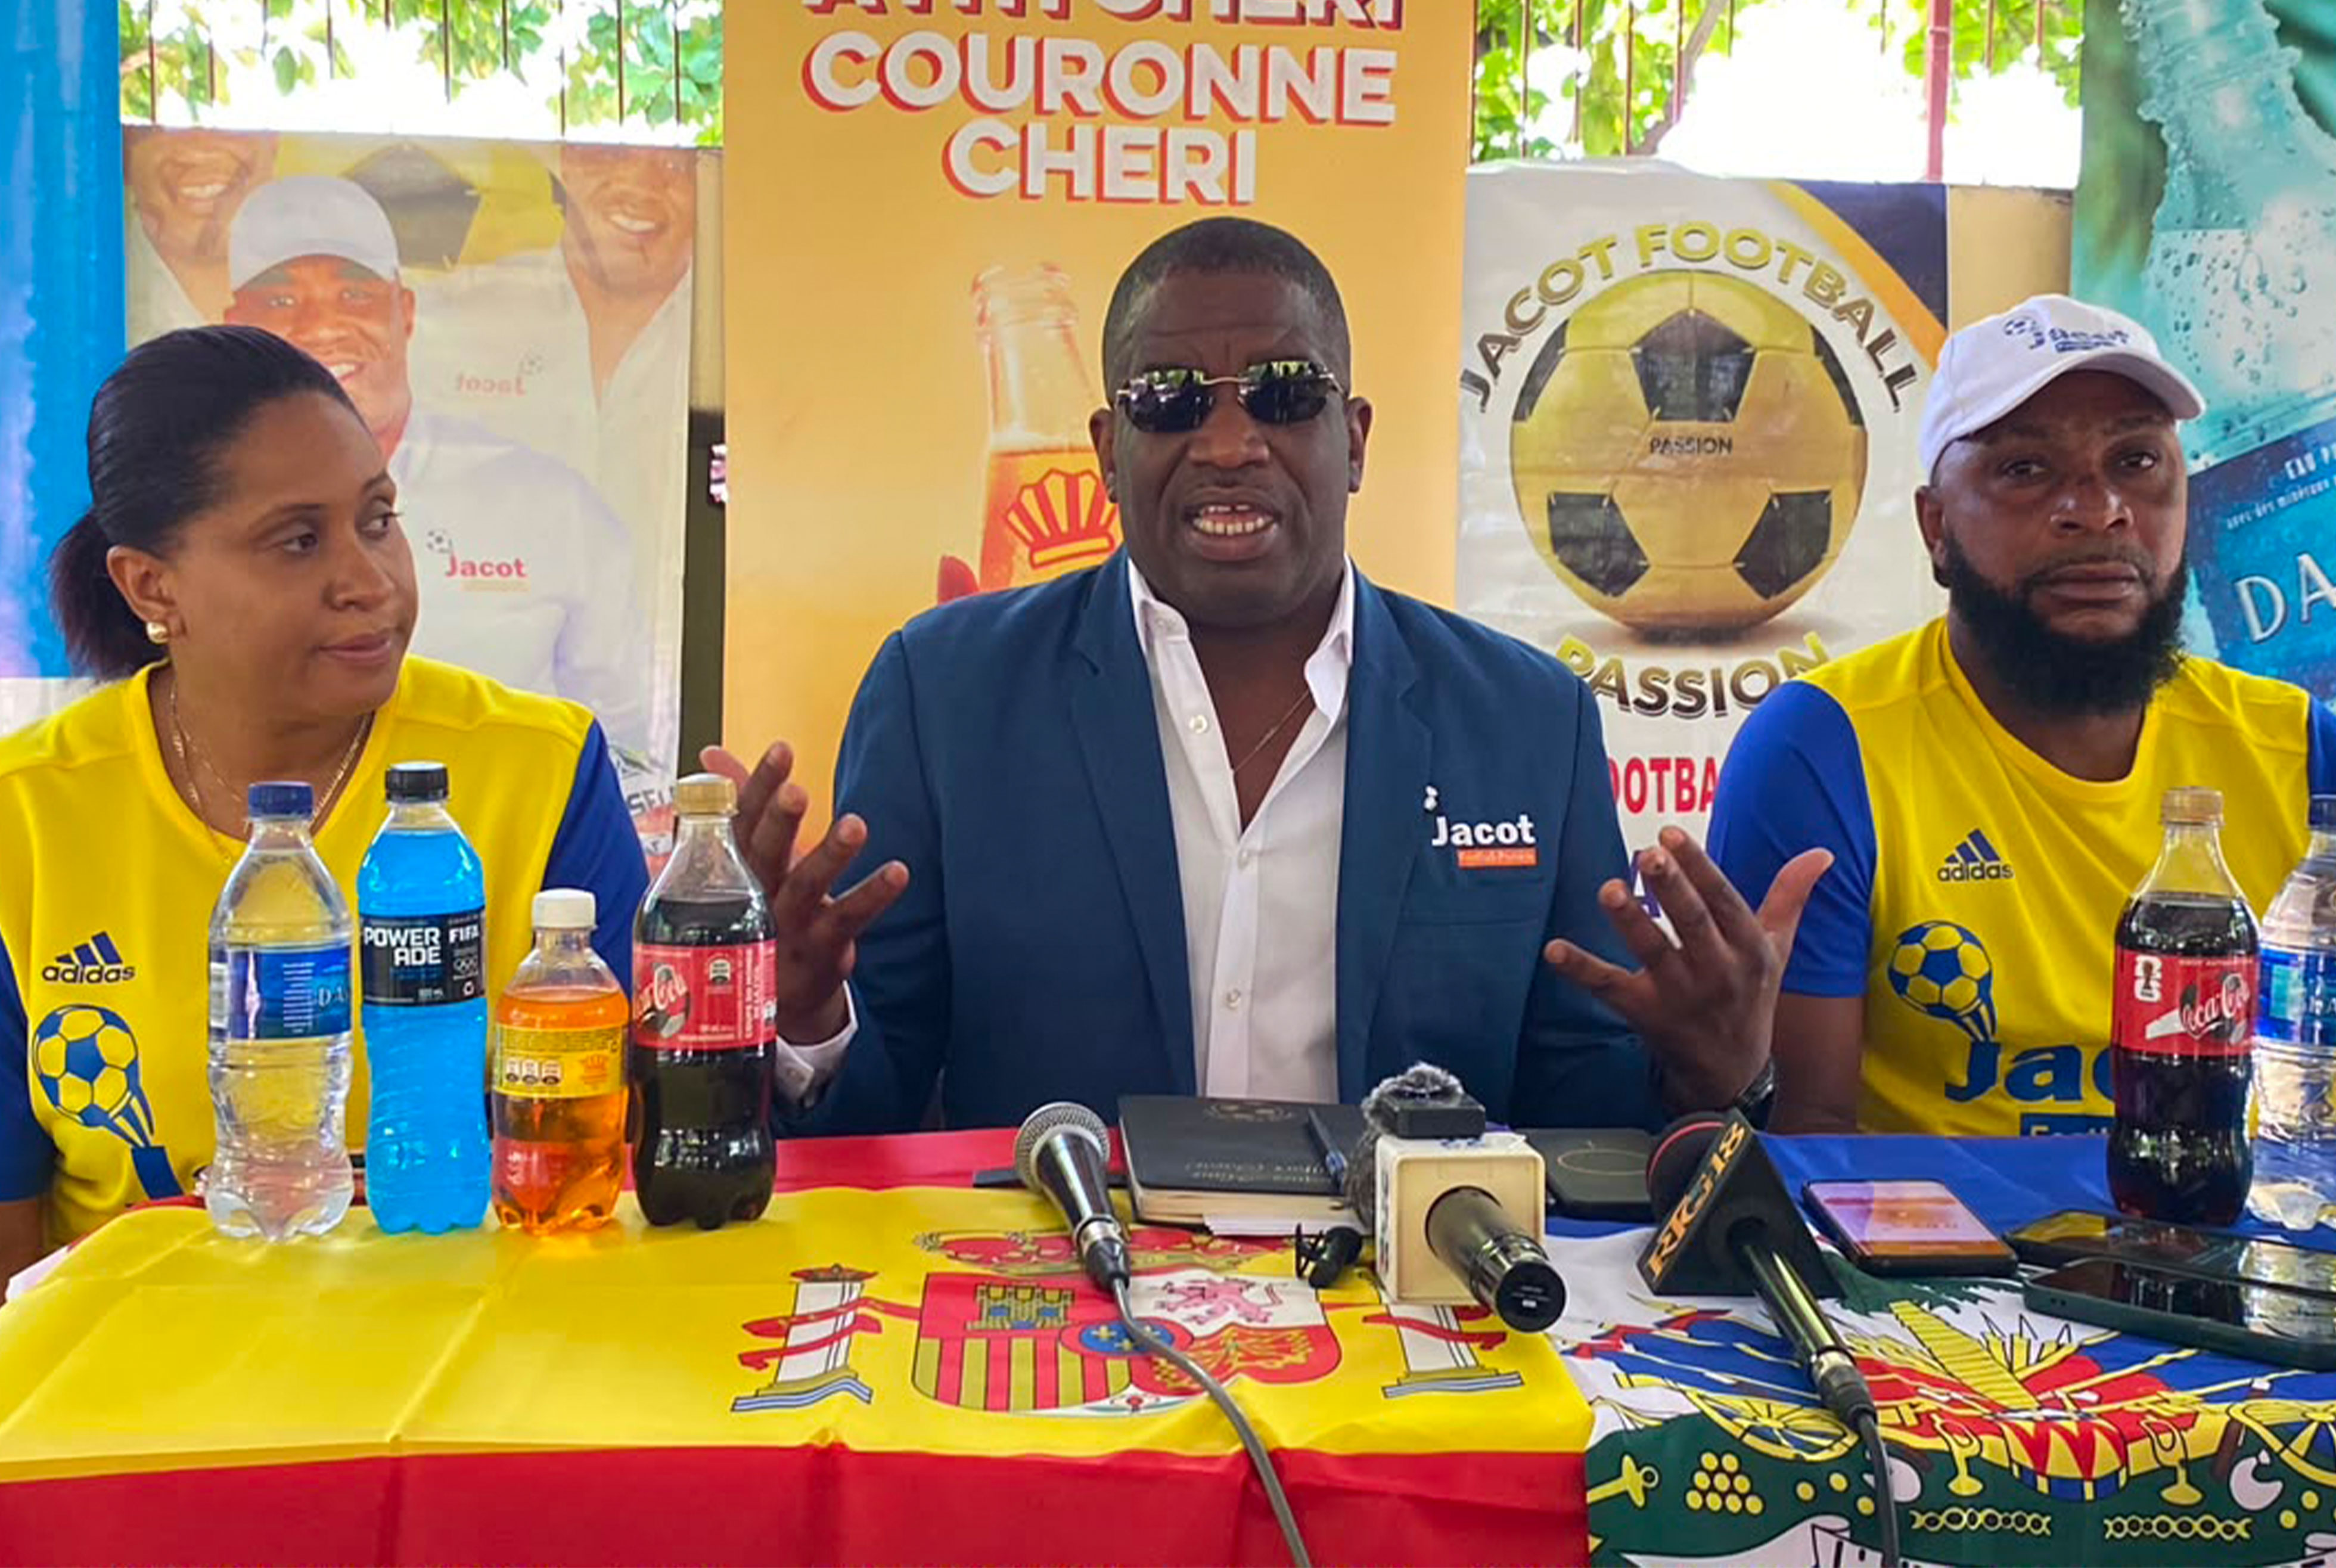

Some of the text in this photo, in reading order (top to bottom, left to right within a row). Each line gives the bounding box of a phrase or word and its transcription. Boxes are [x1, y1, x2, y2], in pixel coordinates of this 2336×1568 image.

[802, 31, 1396, 125] COURONNE
[943, 119, 1256, 205] CHERI
[1460, 220, 1917, 412] JACOT FOOTBALL
[1650, 437, 1732, 455] PASSION
[445, 551, 528, 578] Jacot
[1555, 630, 1831, 719] PASSION
[1431, 814, 1536, 847] Jacot
[1937, 862, 2014, 882] adidas
[363, 926, 442, 947] POWER
[449, 924, 479, 943] FIFA
[393, 946, 442, 966] ADE
[42, 964, 135, 983] adidas
